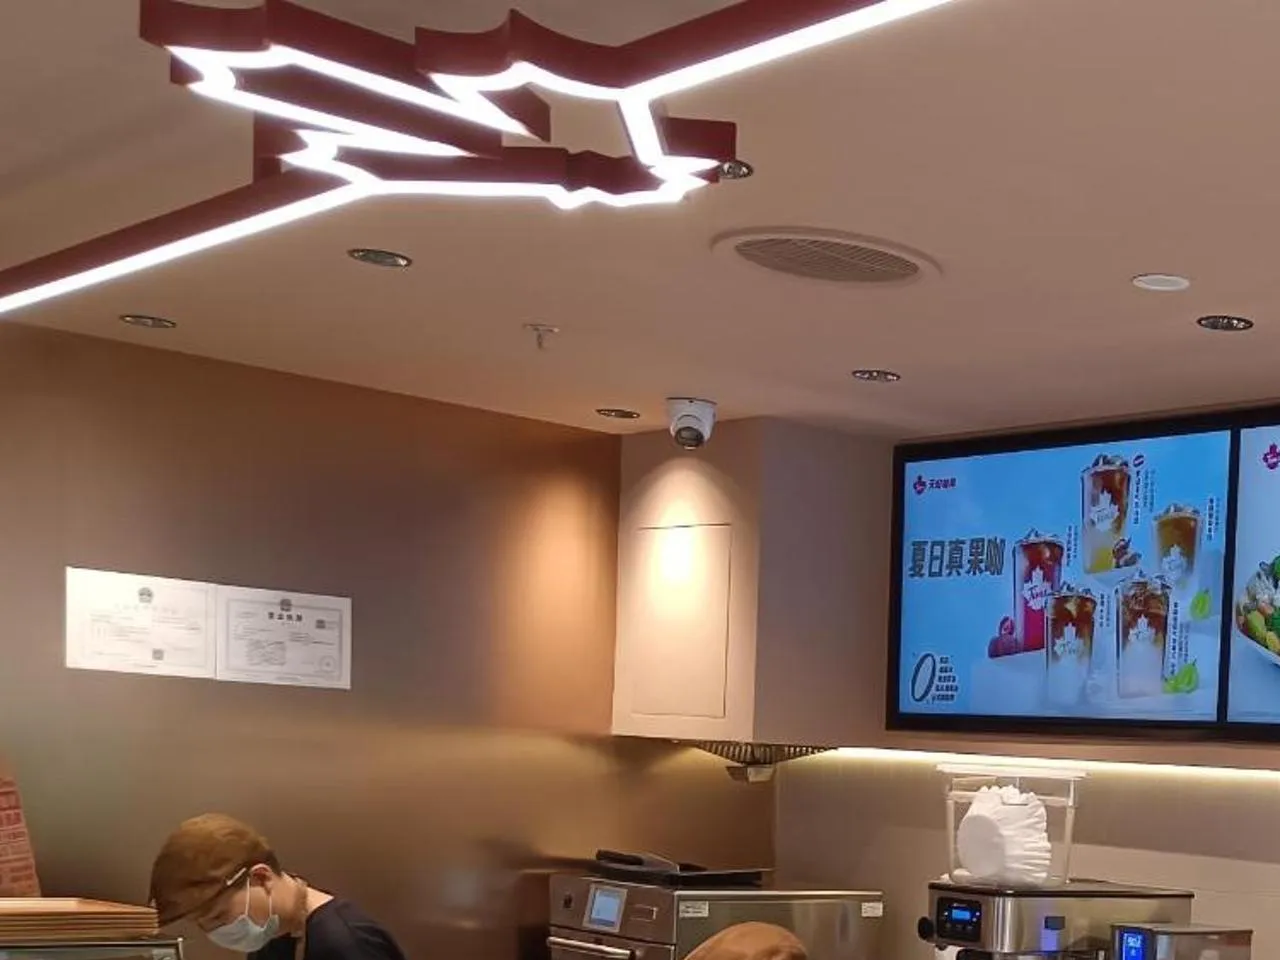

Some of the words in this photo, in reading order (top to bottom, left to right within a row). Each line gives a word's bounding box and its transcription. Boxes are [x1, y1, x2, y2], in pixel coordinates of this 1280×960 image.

[908, 536, 1004, 579] 夏日真果咖
